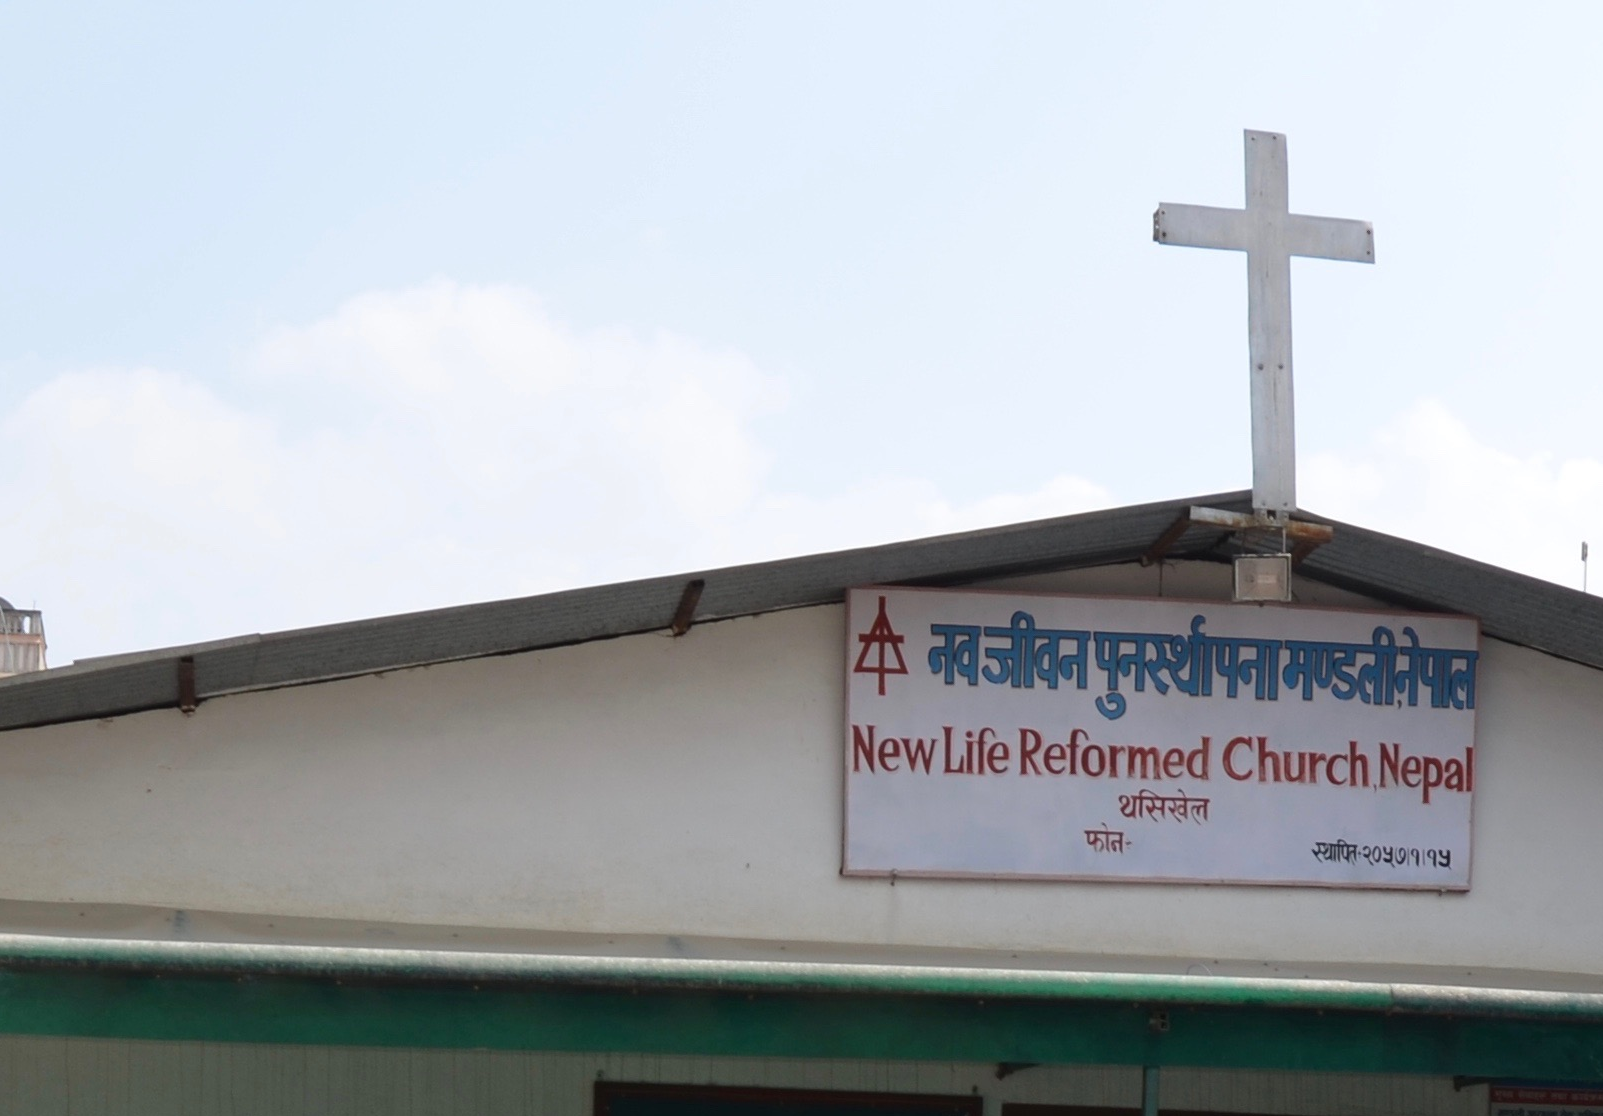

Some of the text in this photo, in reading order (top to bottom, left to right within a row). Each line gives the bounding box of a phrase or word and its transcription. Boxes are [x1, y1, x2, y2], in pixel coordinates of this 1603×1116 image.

[928, 623, 982, 686] नव
[982, 610, 1091, 690] जीवन
[851, 724, 939, 776] New
[943, 725, 1009, 776] Life
[1019, 728, 1210, 781] Reformed
[1379, 742, 1475, 804] Nepal
